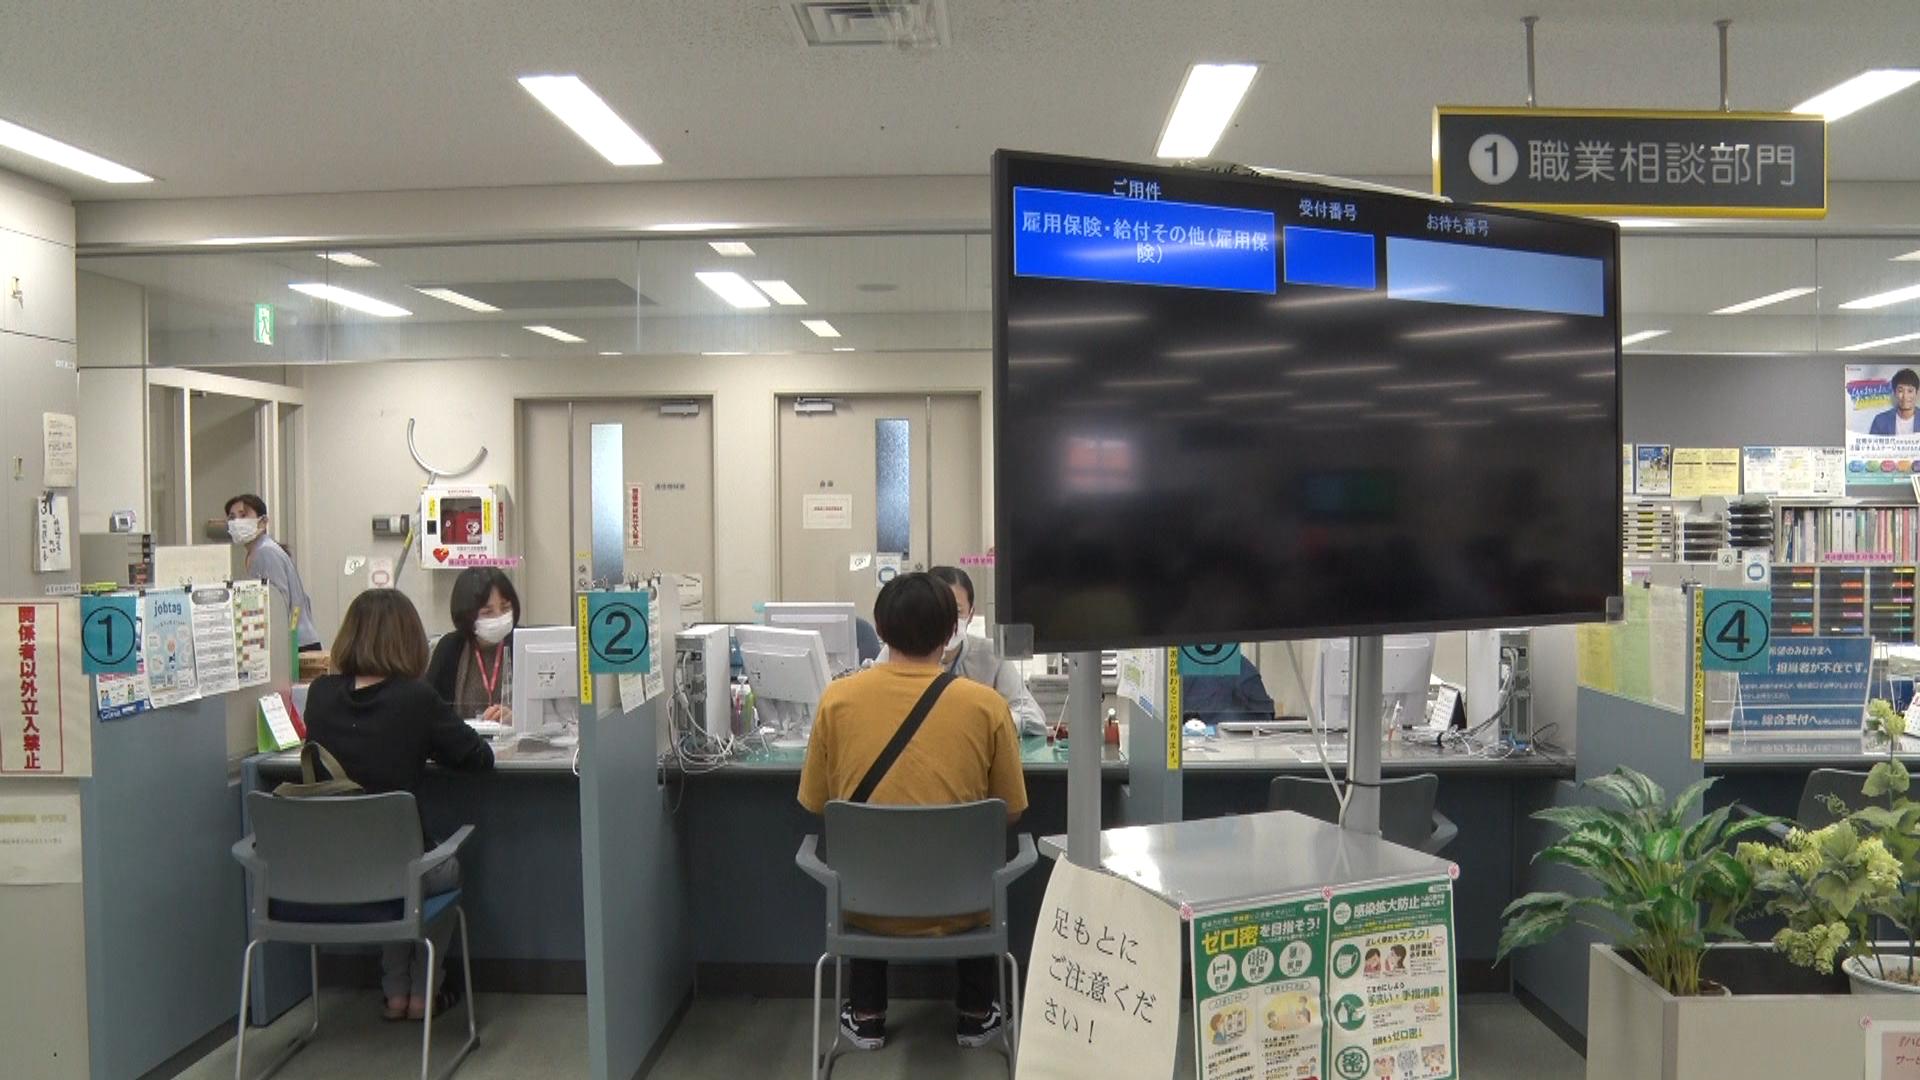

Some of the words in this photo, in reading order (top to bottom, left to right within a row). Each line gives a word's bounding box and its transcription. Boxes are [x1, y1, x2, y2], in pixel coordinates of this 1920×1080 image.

[1528, 139, 1796, 187] 職業相談部門
[1113, 179, 1162, 201] ご用件
[1299, 198, 1358, 222] 受付番号
[1426, 213, 1489, 237] お待ち番号
[18, 606, 41, 769] 関係者以外立入禁止
[1052, 907, 1139, 965] 足もとに
[1049, 953, 1157, 1023] ご注意くだ
[1044, 998, 1095, 1044] さい!
